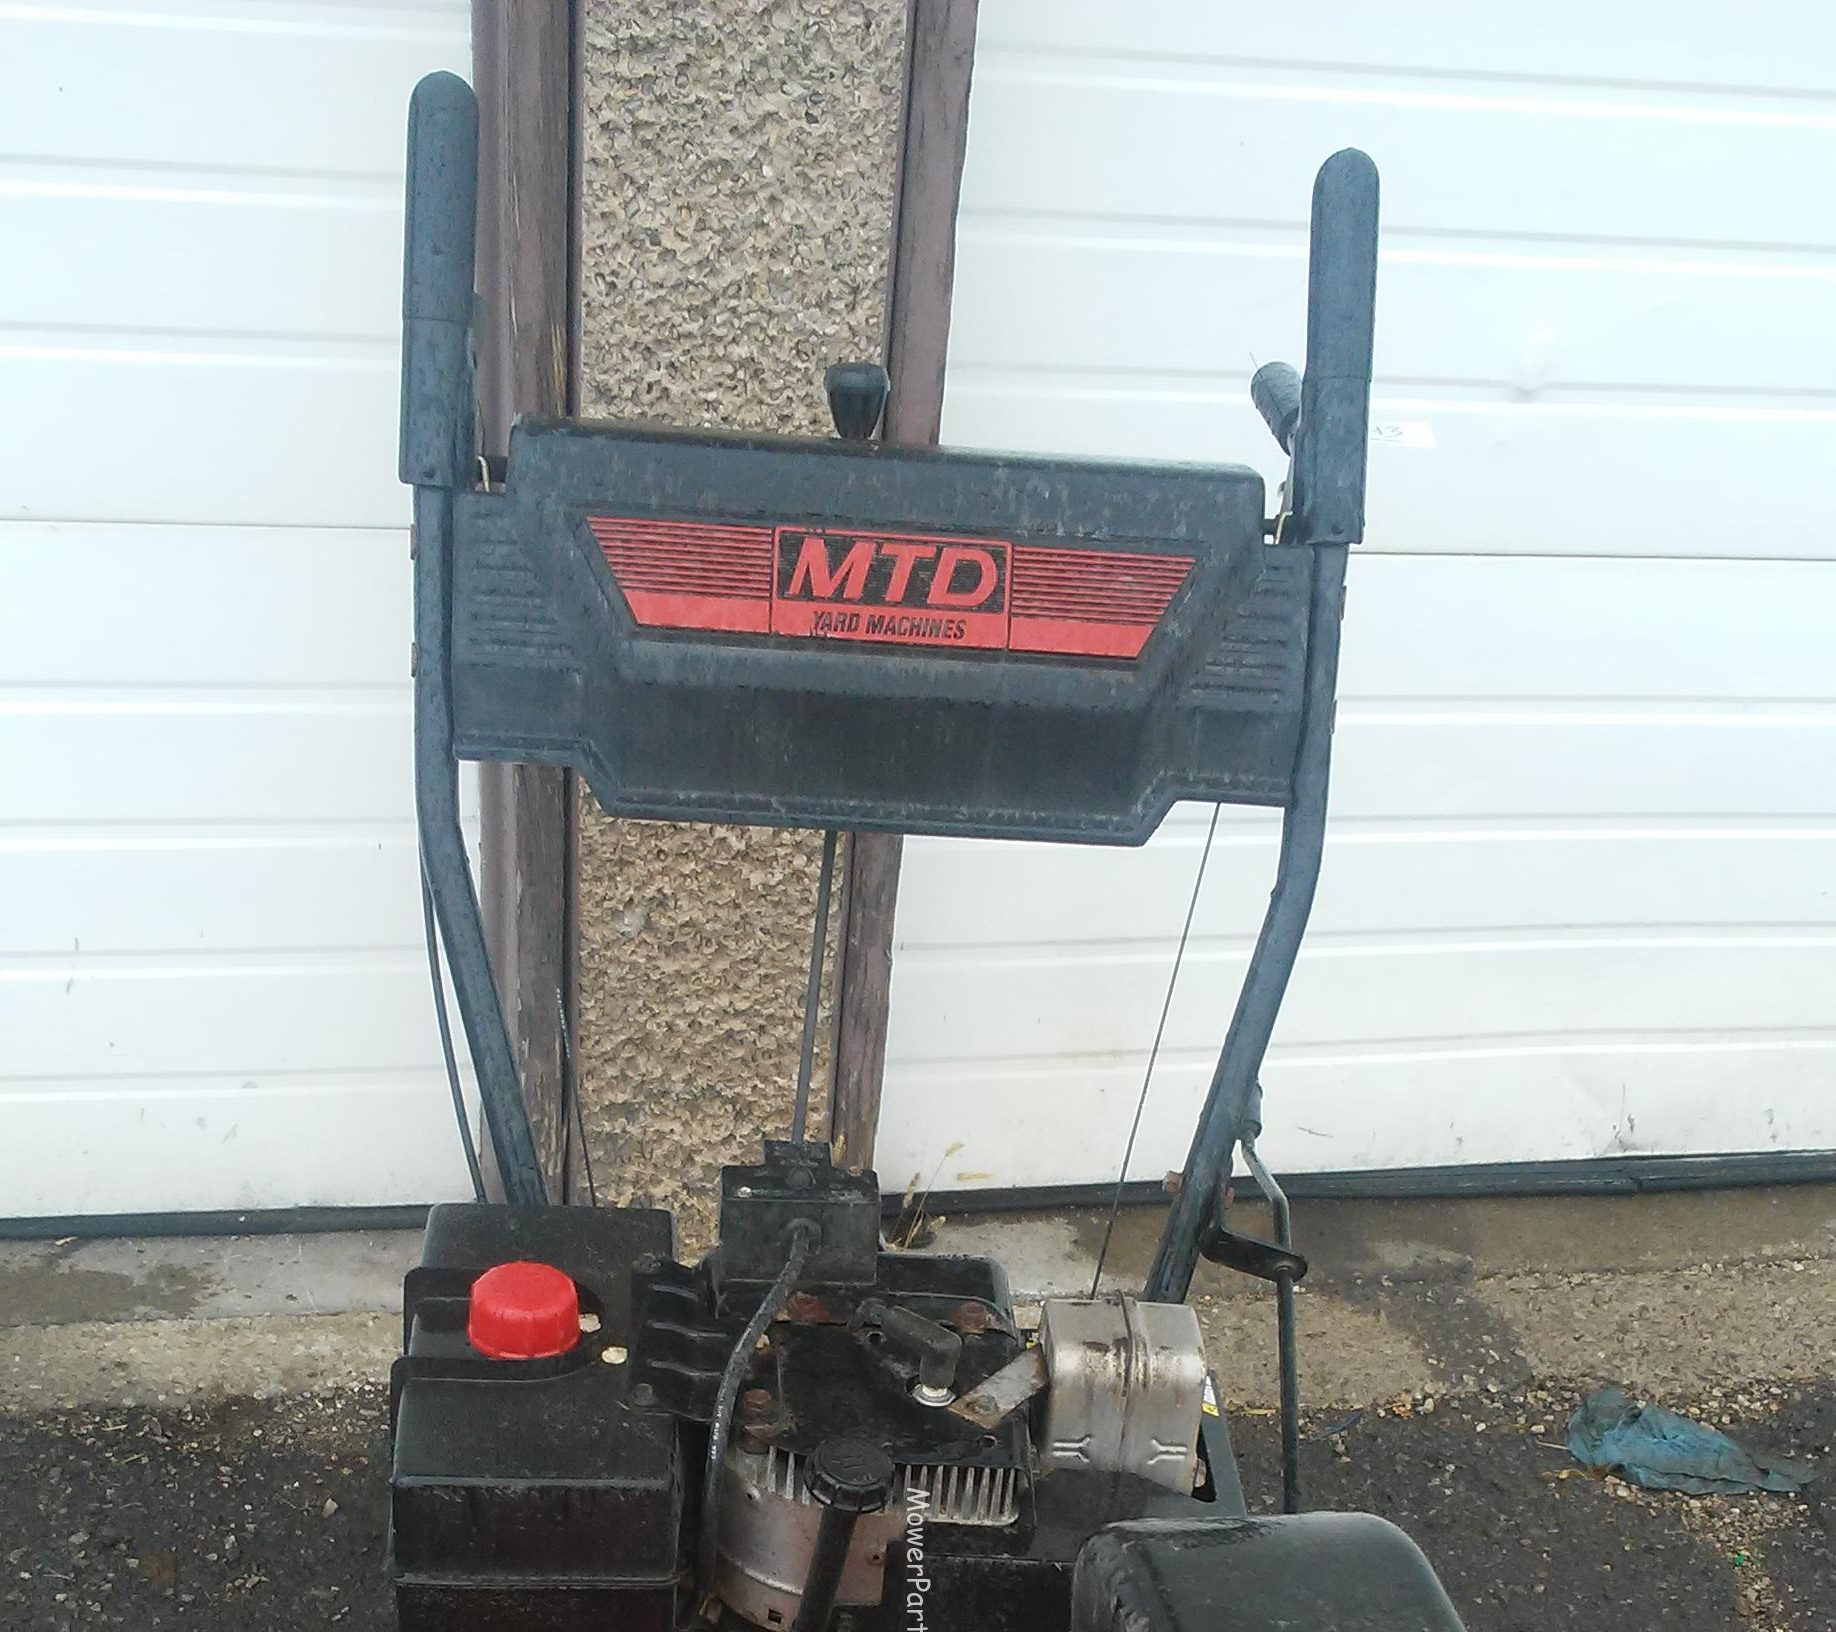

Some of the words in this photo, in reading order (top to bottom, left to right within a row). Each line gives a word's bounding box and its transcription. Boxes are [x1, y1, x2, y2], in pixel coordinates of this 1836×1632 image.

[788, 537, 999, 608] MTD
[812, 609, 860, 635] YARD
[864, 612, 968, 641] MACHINES
